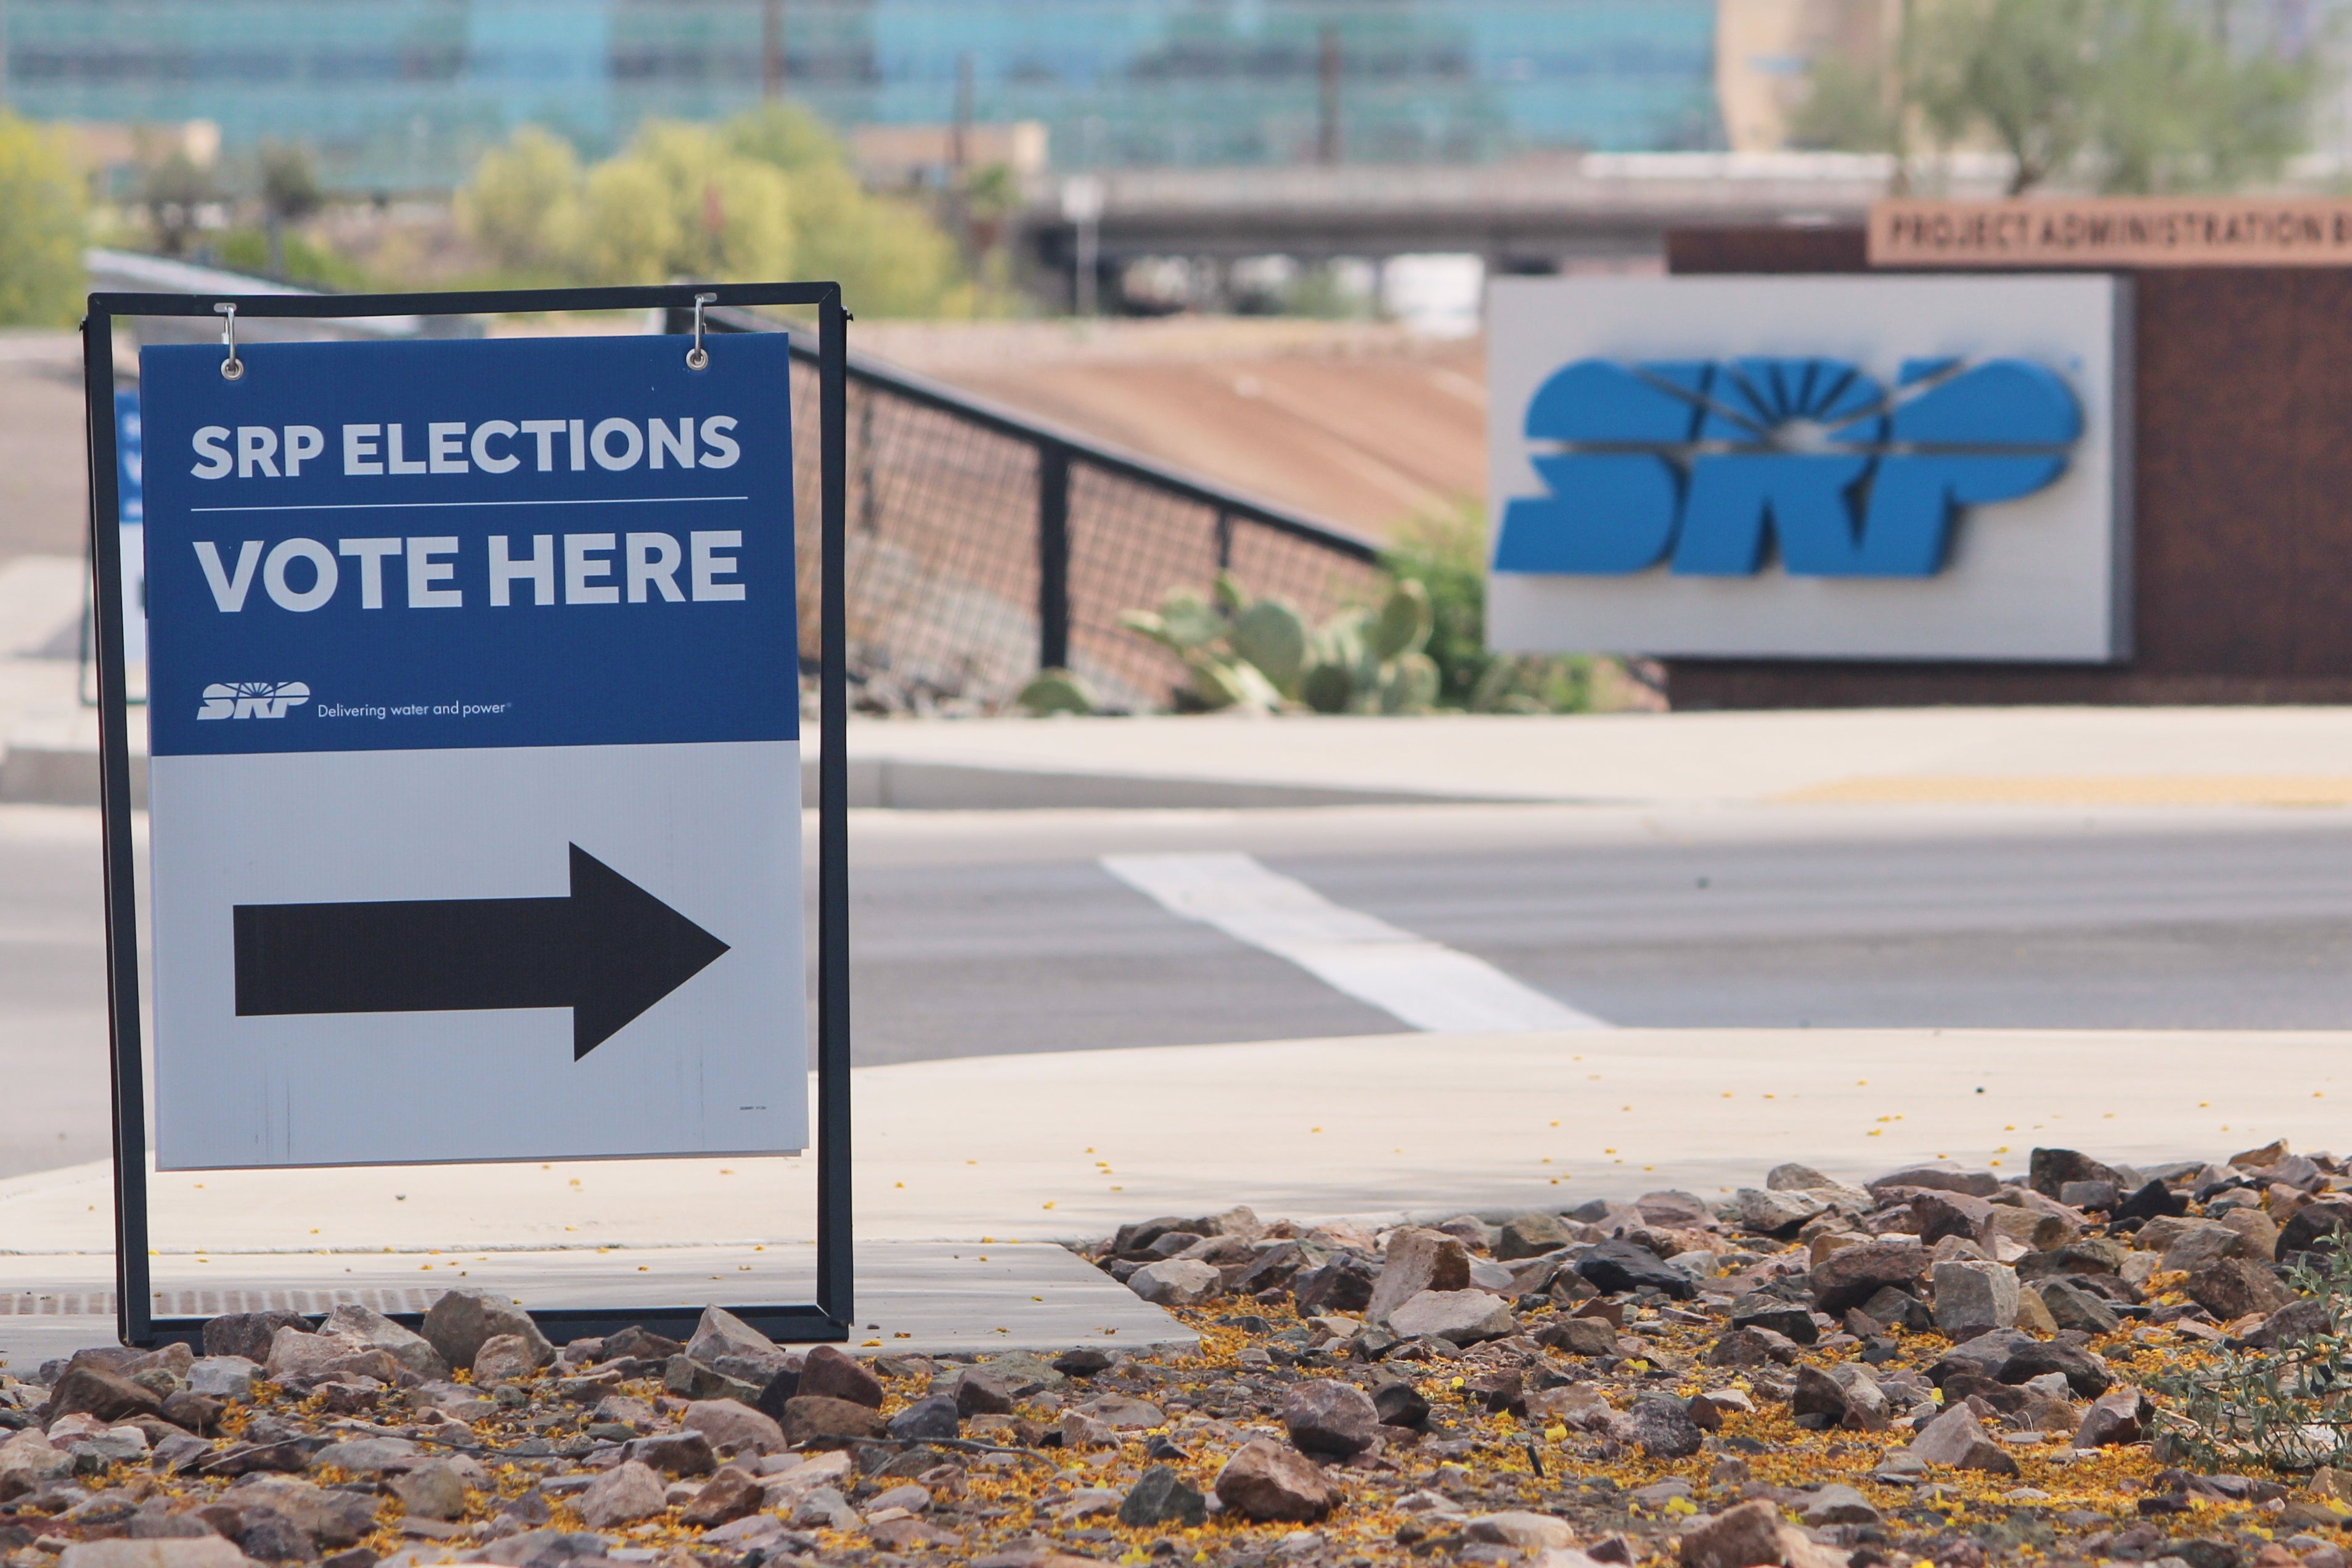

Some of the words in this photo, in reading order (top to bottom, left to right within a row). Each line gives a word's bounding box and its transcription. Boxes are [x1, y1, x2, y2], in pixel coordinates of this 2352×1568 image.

[1889, 213, 2028, 246] PROJECT
[2040, 212, 2322, 245] ADMINISTRATION
[190, 425, 324, 480] SRP
[343, 415, 740, 476] ELECTIONS
[1493, 355, 2082, 578] SRP
[193, 536, 463, 612] VOTE
[488, 530, 746, 606] HERE
[197, 681, 311, 720] SRP
[318, 703, 386, 720] Delivering
[390, 704, 429, 715] water
[433, 700, 459, 714] and
[462, 703, 506, 717] power
